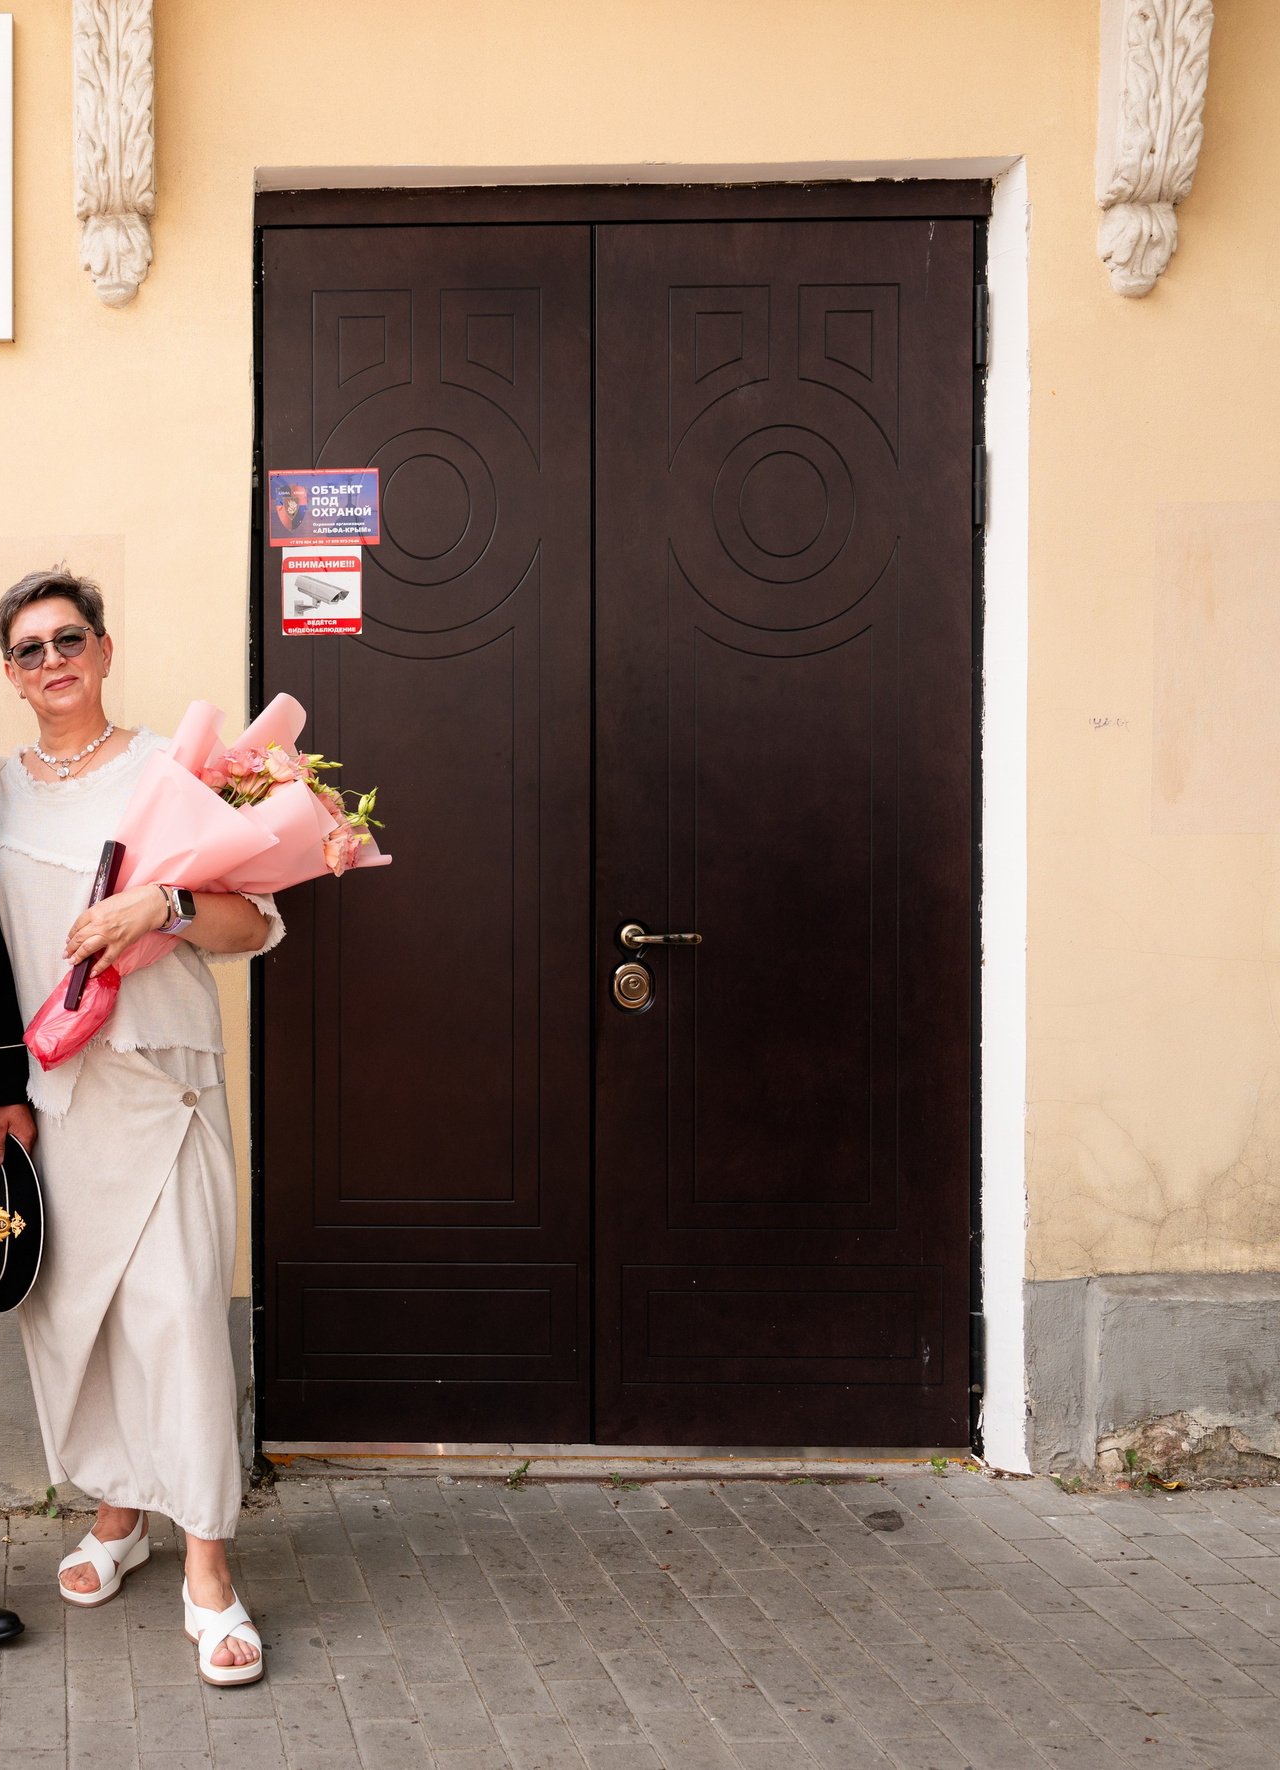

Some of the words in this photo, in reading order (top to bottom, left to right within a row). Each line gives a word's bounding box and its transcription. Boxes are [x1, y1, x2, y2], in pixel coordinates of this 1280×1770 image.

[311, 485, 363, 495] ОБЪЕКТ
[311, 497, 339, 508] ПОД
[311, 505, 372, 517] ОХРАНОЙ
[312, 526, 372, 534] «АЛЬФА-КРЫМ»
[288, 560, 355, 569] ВНИМАНИЕ!!!
[306, 618, 337, 627] ВЕДЁТСЯ
[287, 626, 357, 634] ВИДЕОНАБЛЮДЕНИЕ
